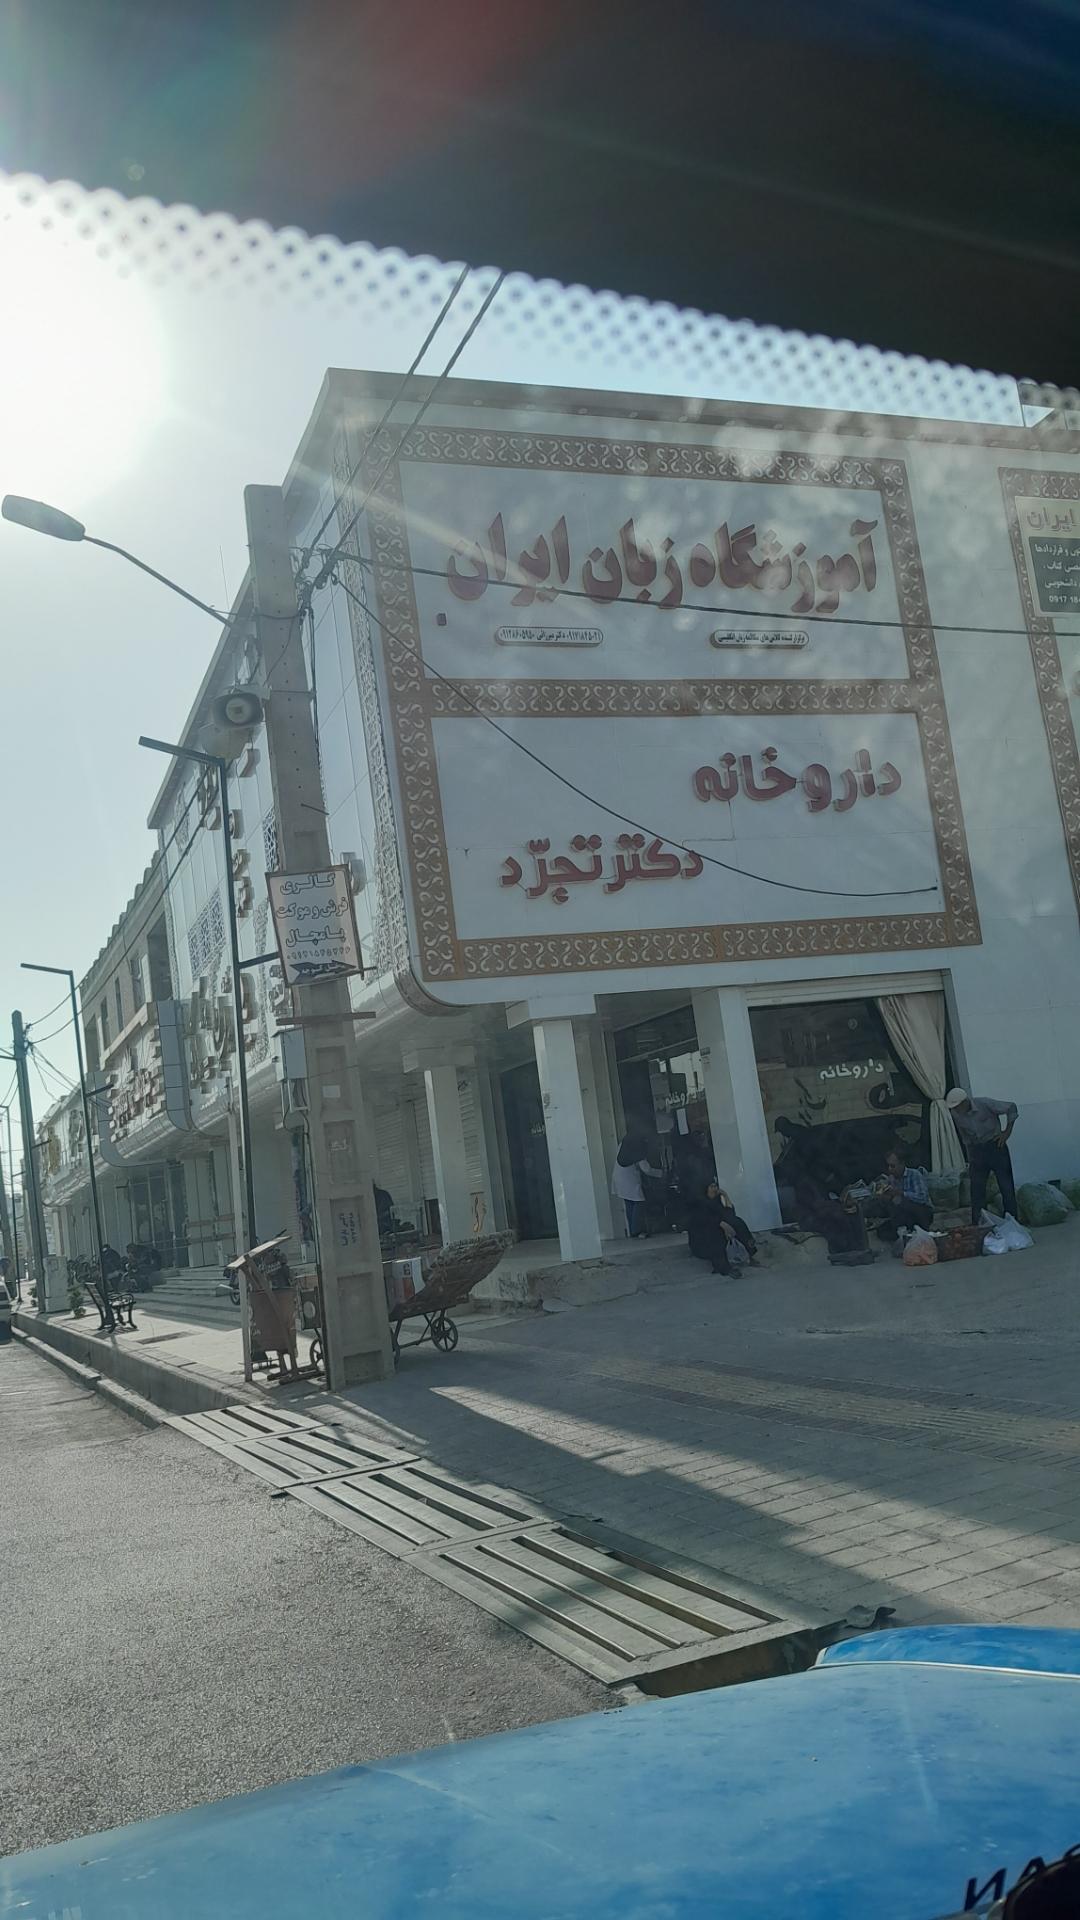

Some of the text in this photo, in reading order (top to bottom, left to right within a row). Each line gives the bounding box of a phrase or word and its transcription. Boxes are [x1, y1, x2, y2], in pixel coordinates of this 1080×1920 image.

[446, 511, 878, 613] آموزشگاه زبان ایران
[693, 746, 902, 813] داروخانه
[603, 833, 704, 894] دکتر
[276, 896, 349, 920] فرش و موکت
[820, 1058, 884, 1080] داروخانه
